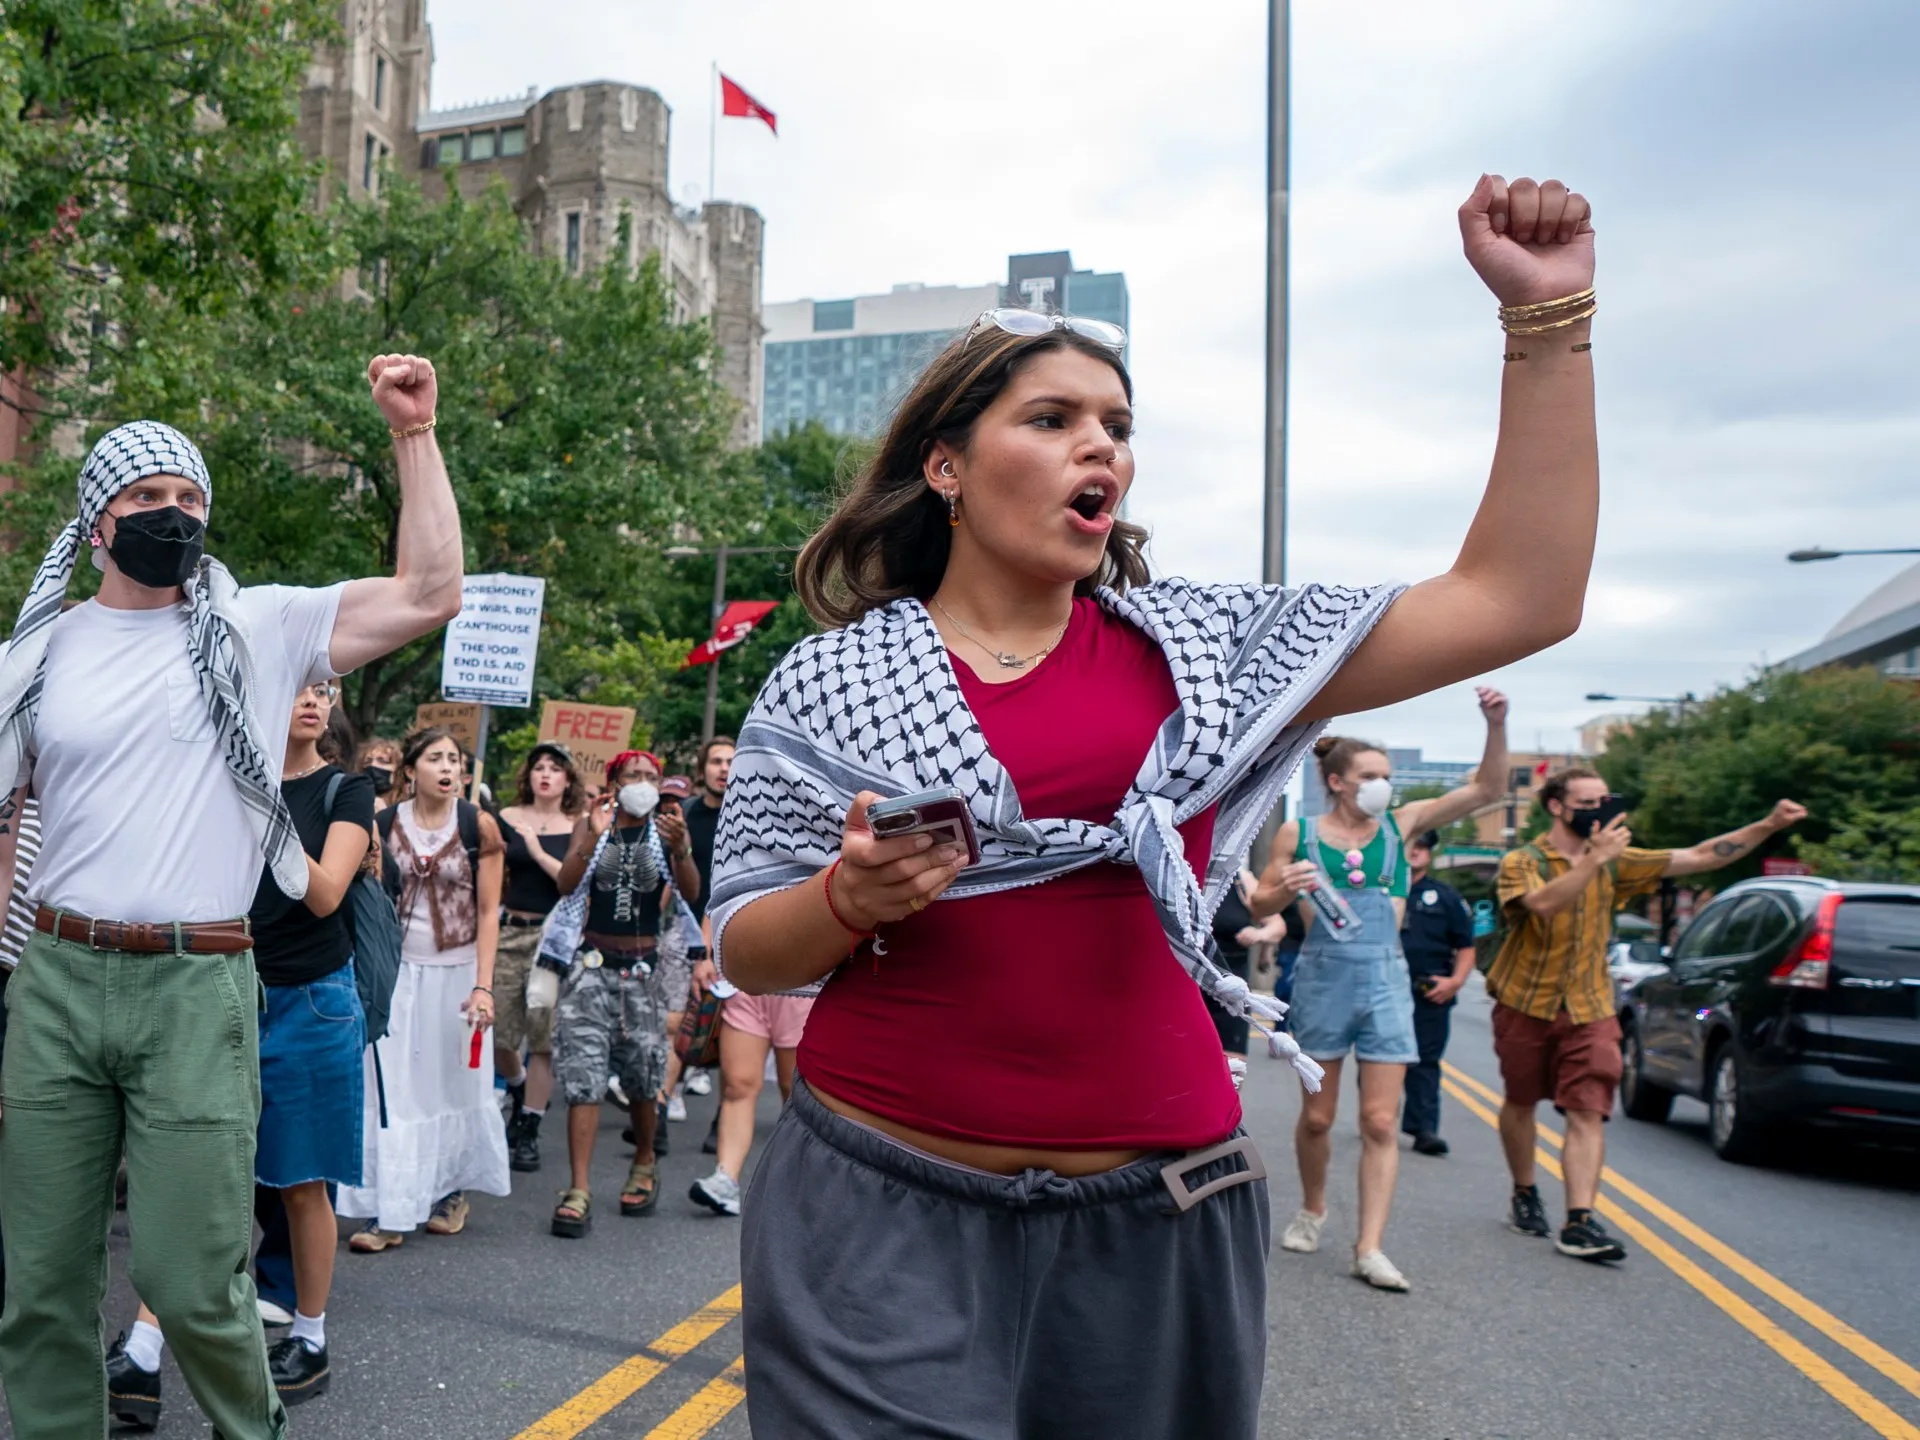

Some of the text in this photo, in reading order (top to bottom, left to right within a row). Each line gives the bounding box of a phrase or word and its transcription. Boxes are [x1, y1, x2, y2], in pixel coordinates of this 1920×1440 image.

[1021, 277, 1055, 313] T
[461, 642, 484, 653] THE
[454, 656, 480, 668] END
[504, 661, 526, 672] AID
[458, 672, 475, 682] TO
[554, 709, 625, 743] FREE
[574, 750, 606, 775] Stin
